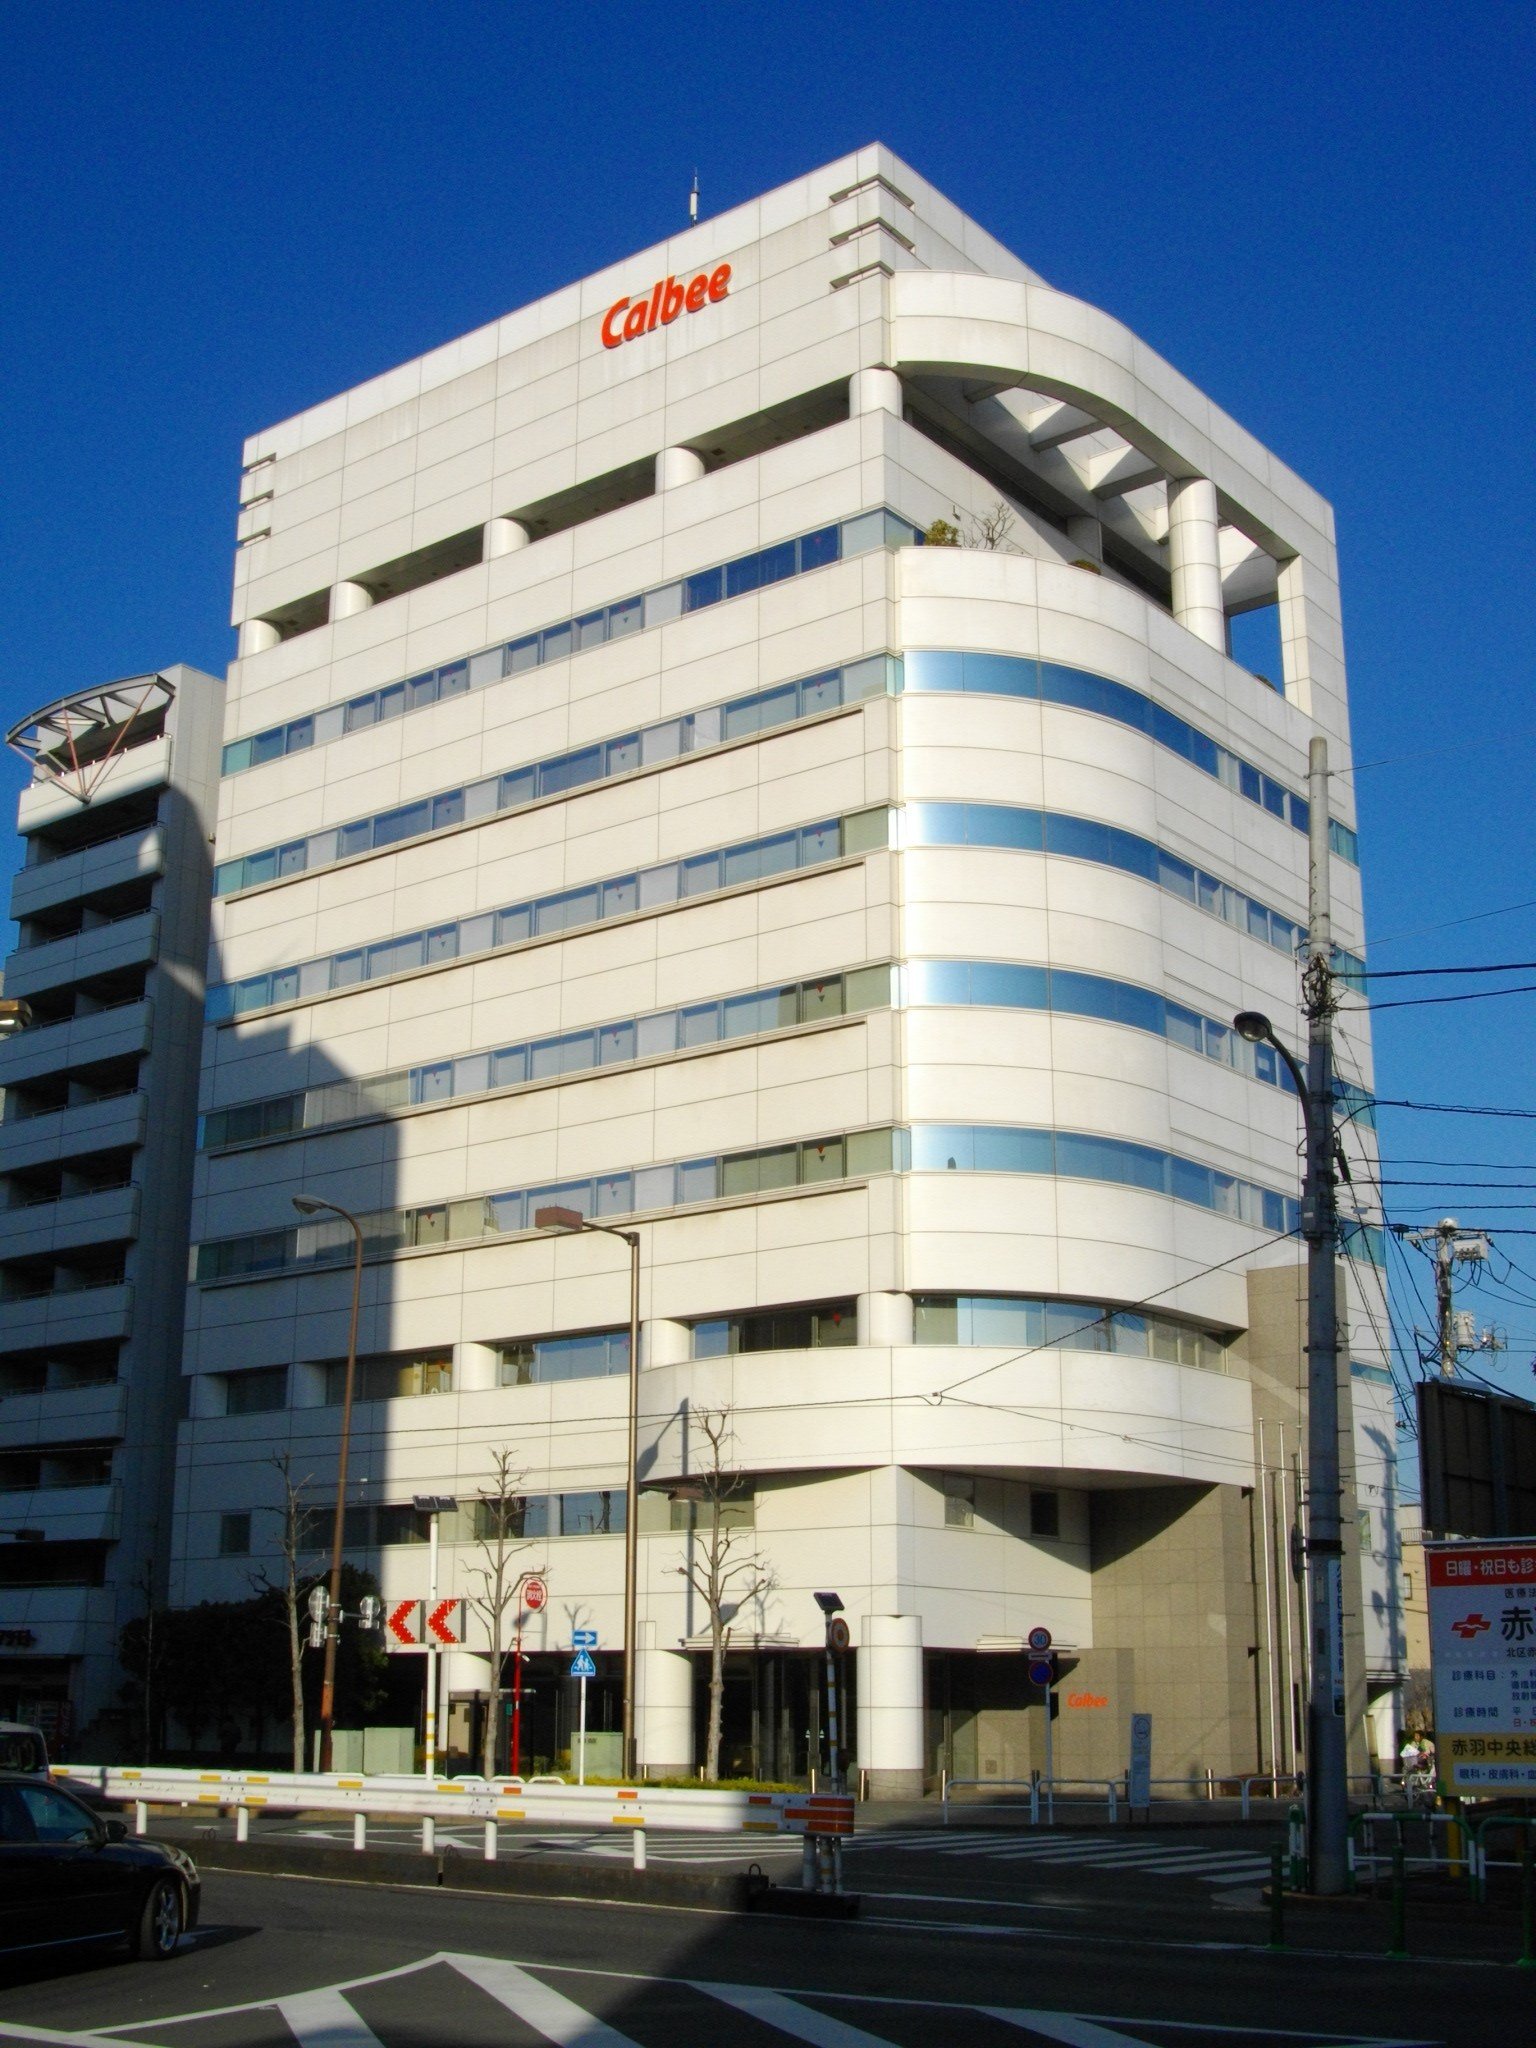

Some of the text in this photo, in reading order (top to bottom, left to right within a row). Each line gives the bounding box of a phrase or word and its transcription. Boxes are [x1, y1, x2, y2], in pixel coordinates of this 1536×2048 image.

[601, 263, 732, 349] Calbee
[1446, 1558, 1536, 1577] 日曜・祝日も診
[1501, 1606, 1536, 1641] 赤
